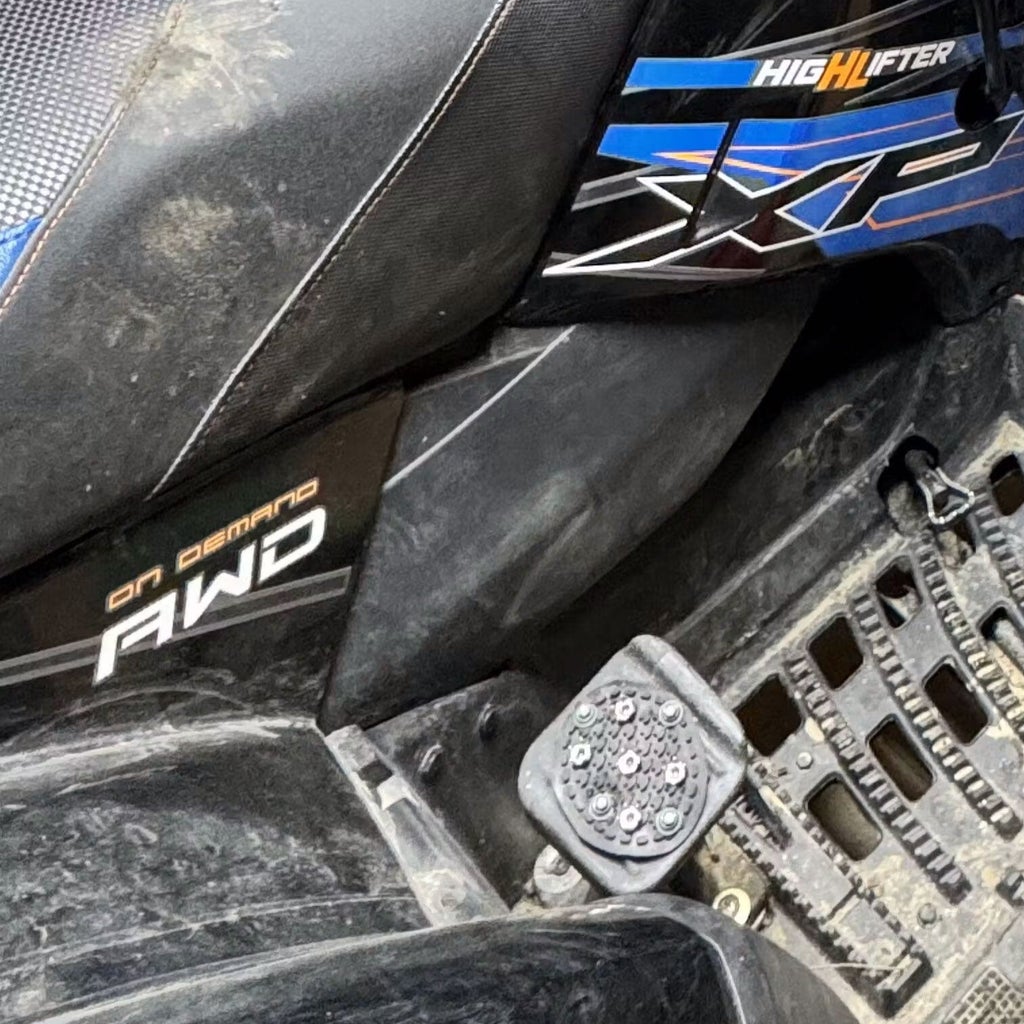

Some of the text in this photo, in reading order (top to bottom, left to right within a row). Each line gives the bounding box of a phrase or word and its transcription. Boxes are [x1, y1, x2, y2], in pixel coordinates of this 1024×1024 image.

[93, 503, 326, 685] AWD
[106, 477, 319, 613] ON DEMAND
